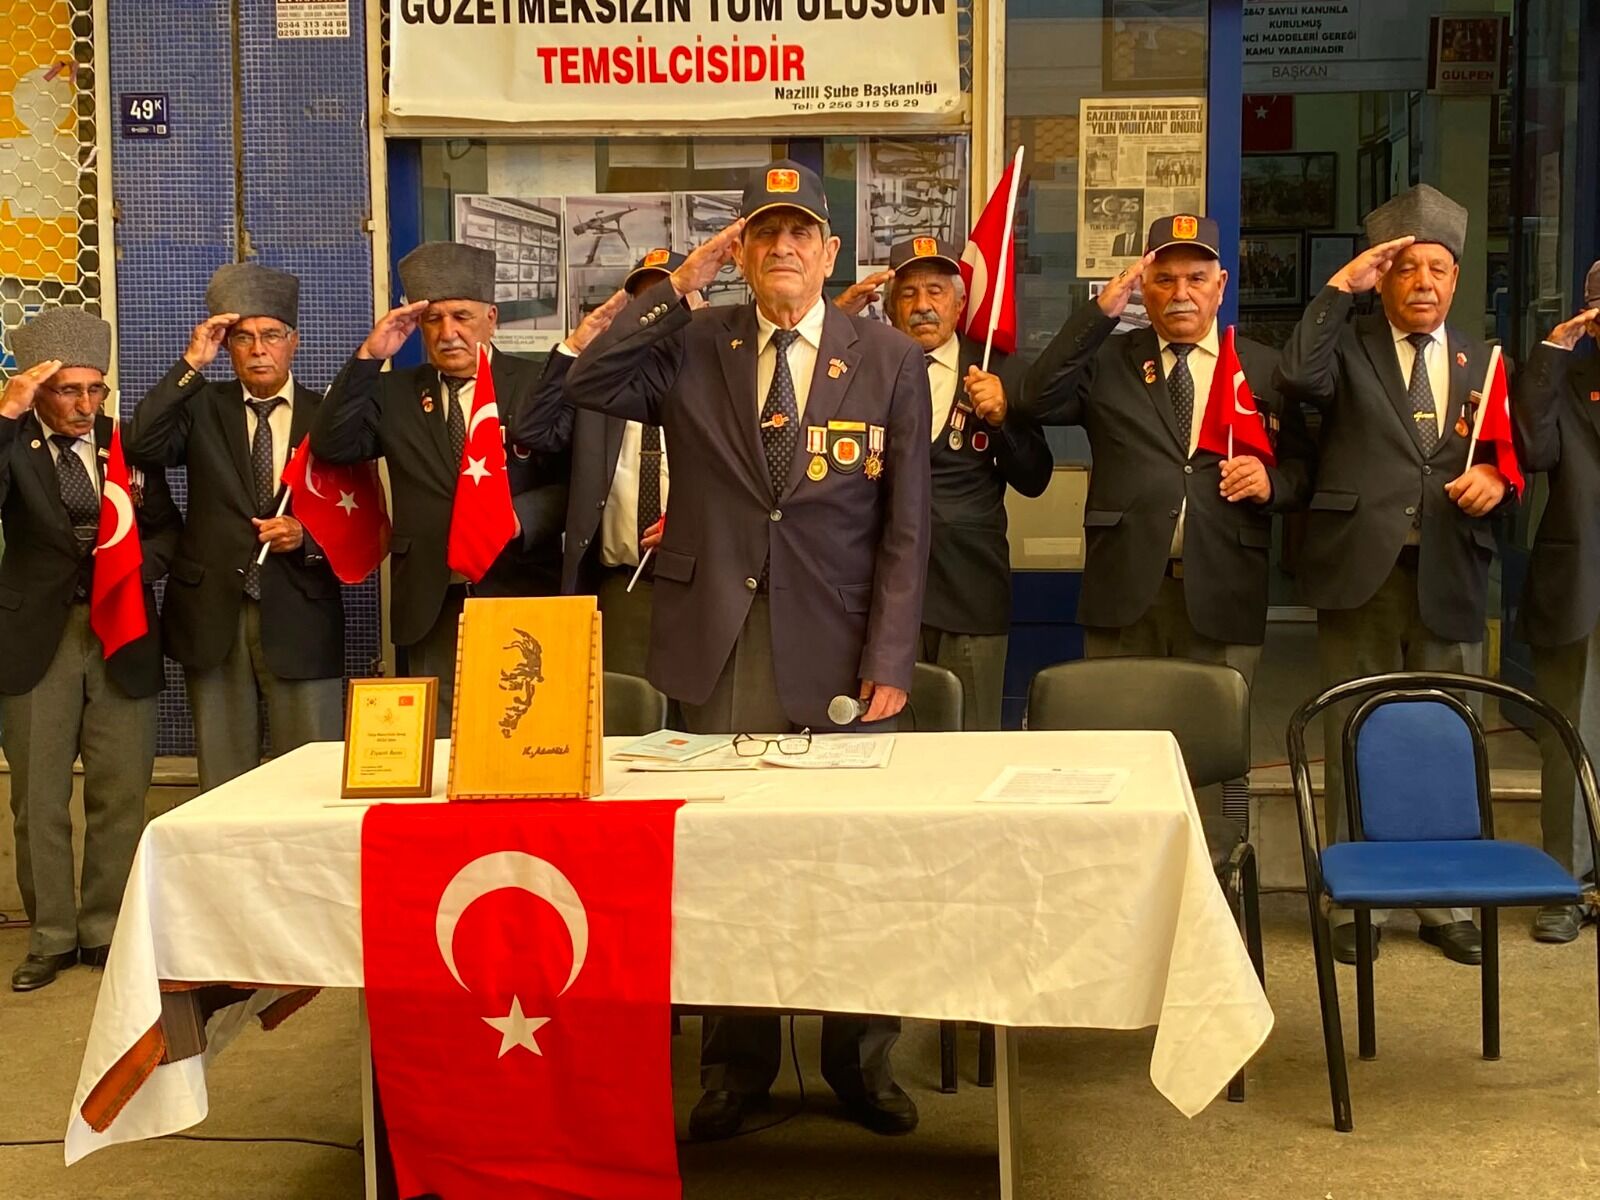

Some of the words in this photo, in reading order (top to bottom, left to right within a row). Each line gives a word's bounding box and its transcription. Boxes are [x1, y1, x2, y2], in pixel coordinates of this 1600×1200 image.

[1301, 5, 1348, 15] KANUNLA
[322, 20, 334, 28] 44
[322, 28, 334, 36] 44
[1245, 47, 1275, 56] KAMU
[536, 33, 805, 85] TEMSİLCİSİDİR
[1271, 65, 1328, 80] BAŞKAN
[774, 86, 819, 100] Nazilli
[823, 84, 859, 100] Şube
[863, 81, 938, 98] Başkanlığı
[792, 102, 813, 111] Tel:
[817, 102, 825, 110] 0
[829, 101, 852, 109] 256
[856, 100, 879, 109] 315
[883, 99, 899, 108] 56
[903, 98, 919, 107] 29
